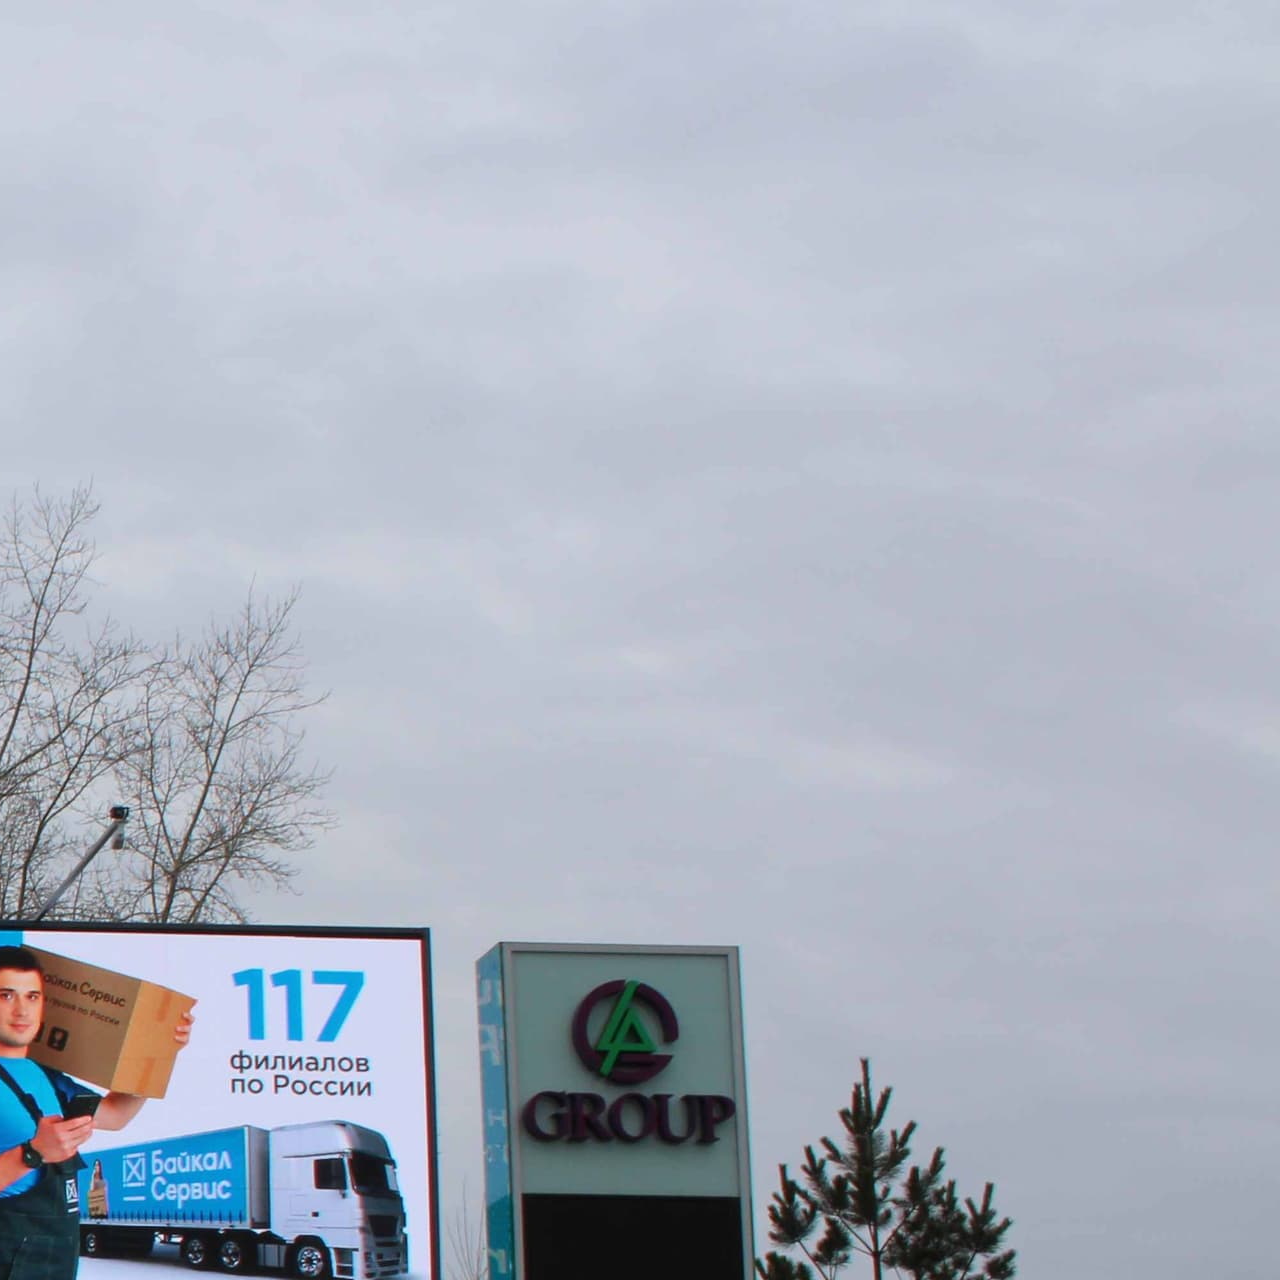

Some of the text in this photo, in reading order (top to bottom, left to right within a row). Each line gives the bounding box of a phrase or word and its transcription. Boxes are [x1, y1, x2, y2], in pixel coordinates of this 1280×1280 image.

[44, 974, 78, 993] айкал
[79, 981, 127, 1008] Сервис
[231, 968, 366, 1043] 117
[229, 1049, 371, 1075] филиалов
[230, 1074, 373, 1097] по России
[521, 1090, 737, 1146] GROUP
[150, 1149, 233, 1176] Байкал
[150, 1176, 233, 1210] Сервис
